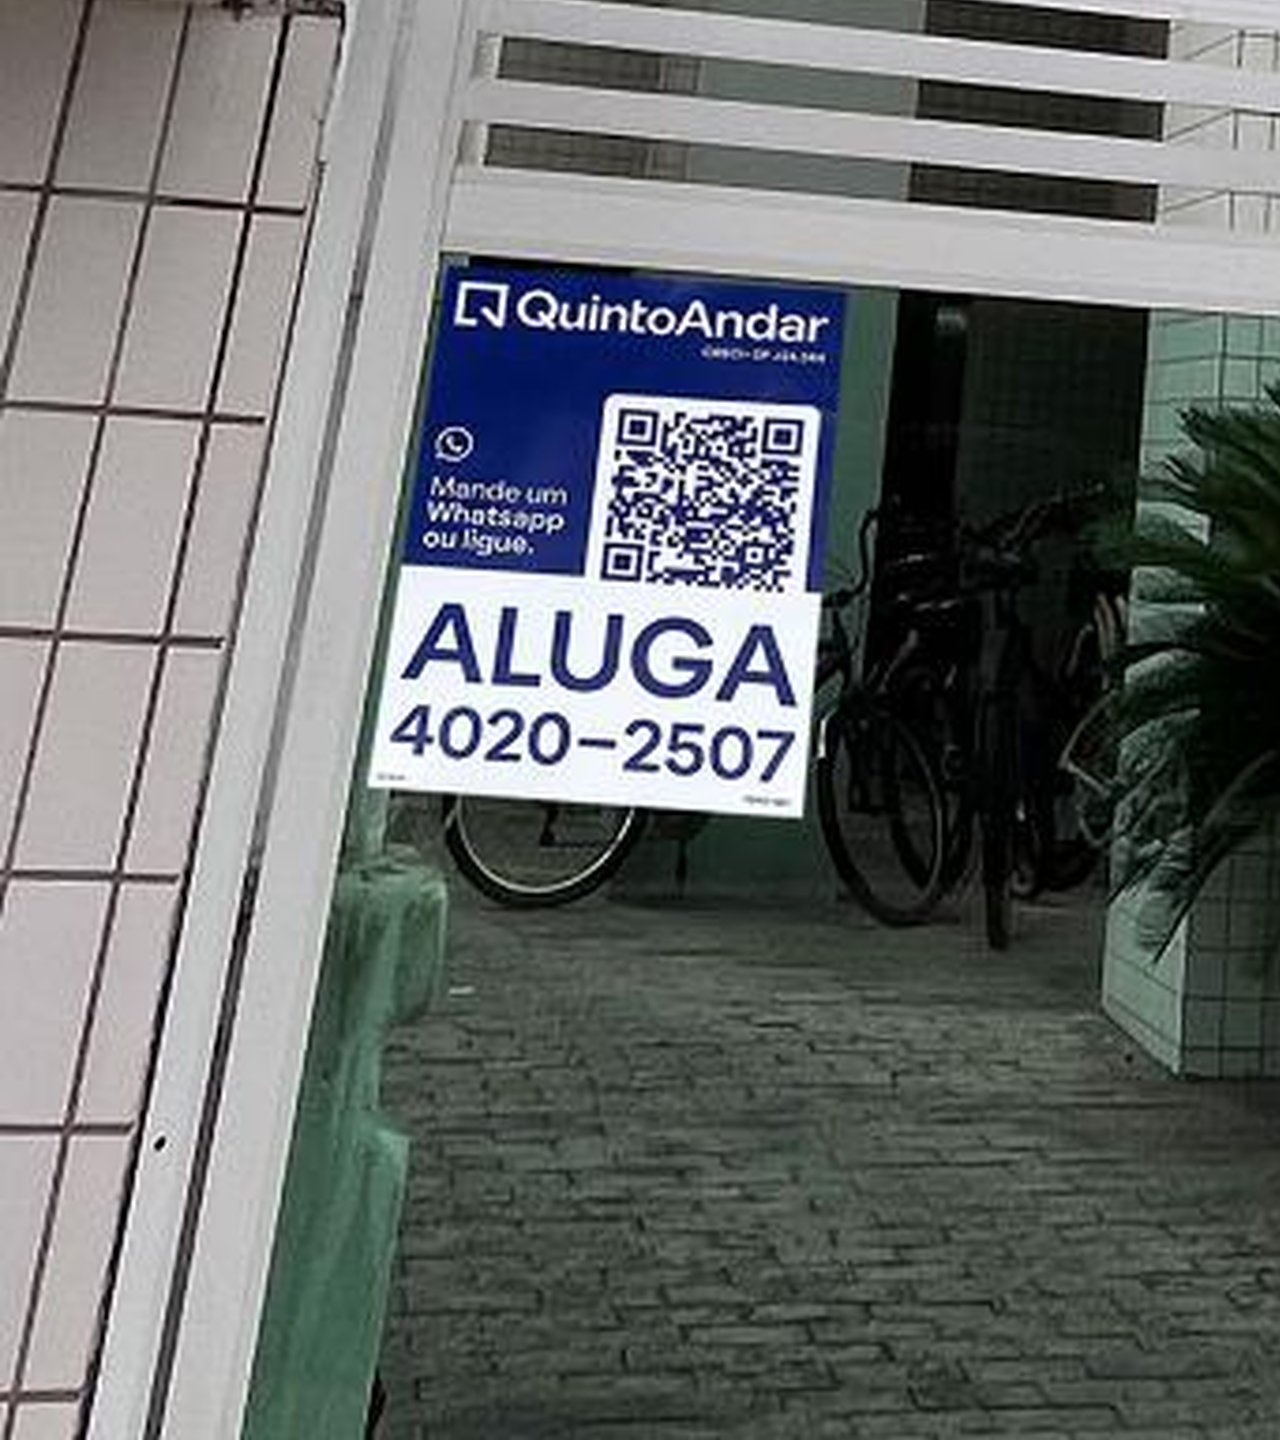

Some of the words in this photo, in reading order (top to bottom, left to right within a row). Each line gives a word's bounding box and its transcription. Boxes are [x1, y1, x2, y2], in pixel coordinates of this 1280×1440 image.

[516, 288, 830, 343] QuintoAndar
[430, 476, 521, 503] Mande
[526, 487, 568, 506] um
[426, 500, 564, 533] Whatsapp
[422, 531, 458, 549] ou
[461, 524, 535, 556] ligue.
[400, 602, 798, 708] ALUGA
[389, 704, 797, 784] 4020-2507
